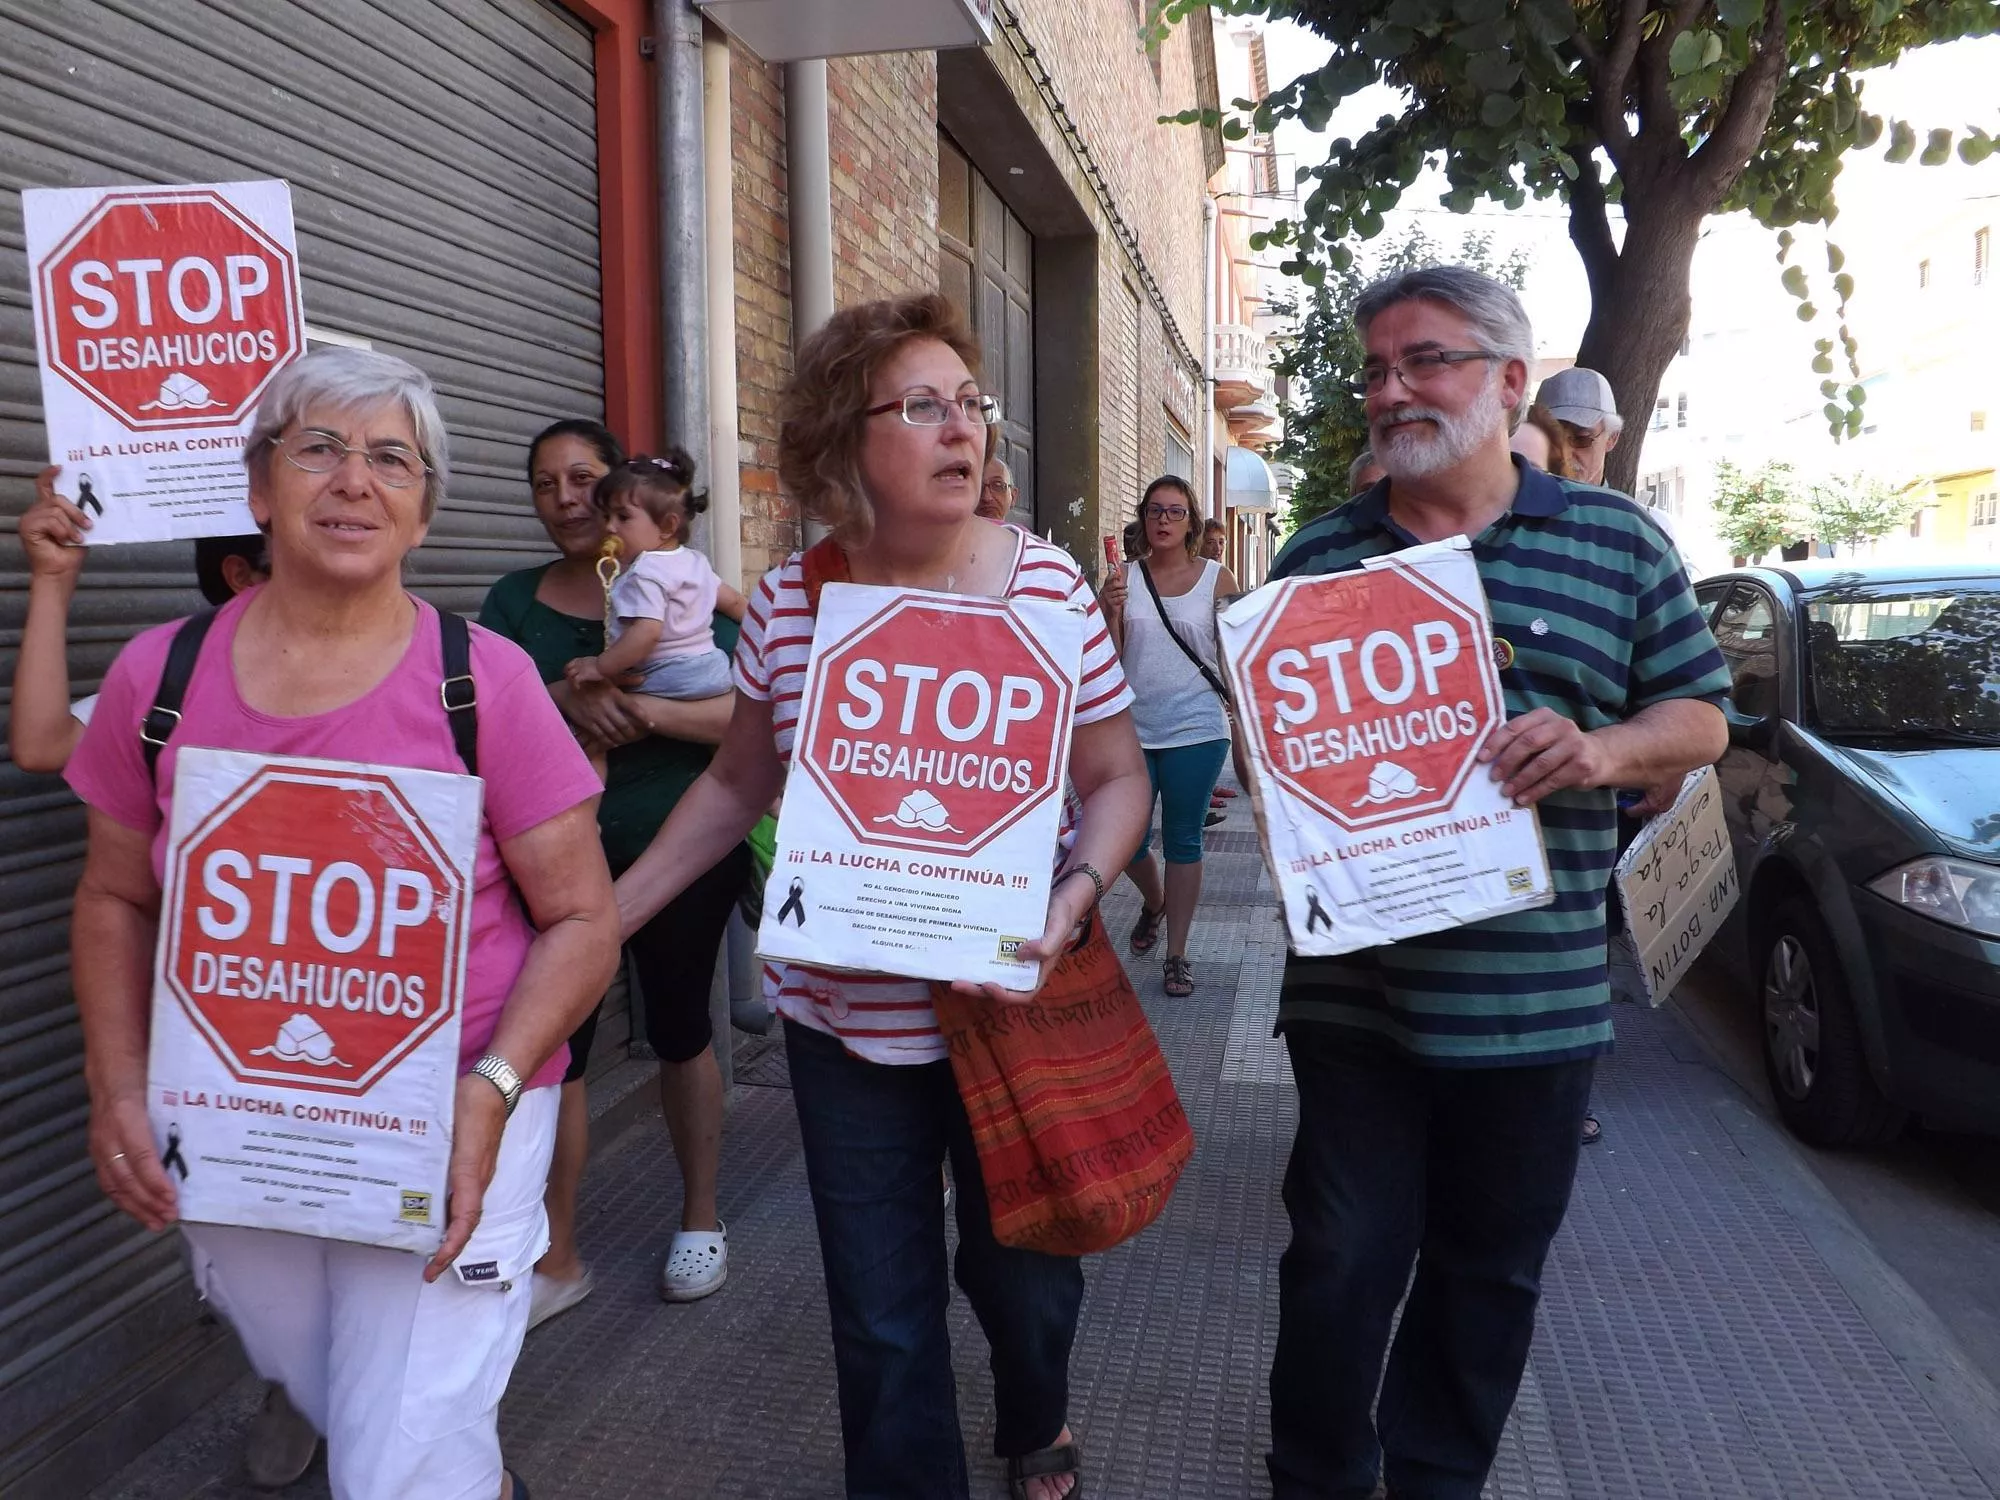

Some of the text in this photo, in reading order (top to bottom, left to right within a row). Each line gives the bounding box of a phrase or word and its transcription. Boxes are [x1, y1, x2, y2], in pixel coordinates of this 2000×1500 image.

[70, 255, 269, 330] STOP
[76, 329, 278, 373] DESAHUCIOS
[89, 445, 112, 457] LA
[118, 440, 180, 455] LUCHA
[185, 436, 250, 451] CONTIN
[1267, 620, 1460, 725] STOP
[837, 658, 1043, 746] STOP
[1282, 700, 1478, 774] DESAHUCIOS
[828, 738, 1032, 794] DESAHUCIOS
[1310, 851, 1334, 866] LA
[1336, 836, 1395, 861] LUCHA
[1401, 815, 1491, 846] CONTINÚA
[810, 850, 833, 864] LA
[839, 853, 901, 873] LUCHA
[907, 862, 1006, 886] CONTINÚA
[1012, 874, 1029, 889] !!!
[921, 891, 960, 900] FINANCIERO
[197, 849, 435, 959] STOP
[910, 903, 940, 912] VIVIENDA
[941, 907, 962, 915] DIGNA
[963, 924, 998, 933] VIVIENDAS
[1653, 914, 1702, 991] BOTIN
[192, 951, 426, 1019] DESAHUCIOS
[183, 1090, 207, 1109] LA
[216, 1094, 286, 1117] LUCHA
[293, 1103, 403, 1133] CONTINÚA
